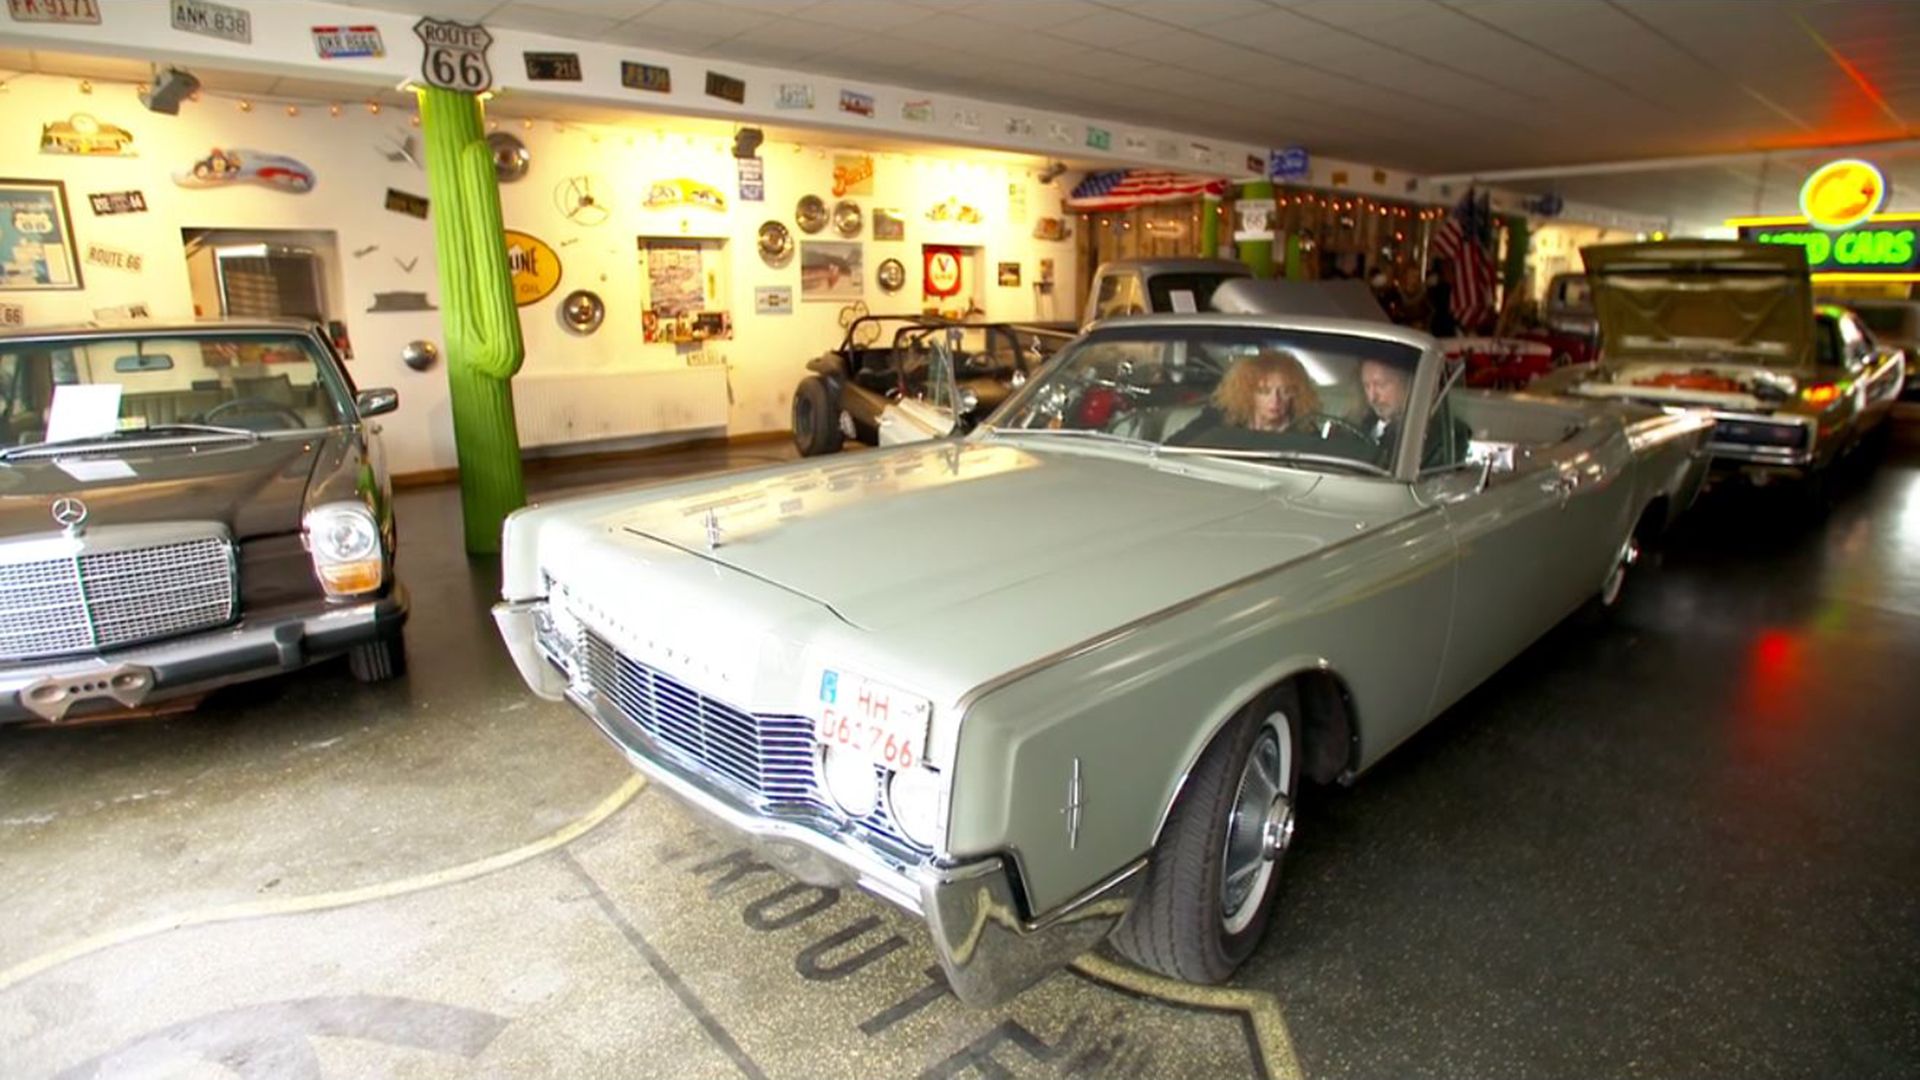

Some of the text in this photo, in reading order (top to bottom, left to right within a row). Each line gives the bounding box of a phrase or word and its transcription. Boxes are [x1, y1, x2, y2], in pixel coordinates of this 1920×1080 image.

[176, 5, 208, 27] ANK
[425, 25, 481, 47] ROUTE
[432, 49, 482, 87] 66
[89, 246, 142, 271] ROUTE 66
[508, 247, 539, 277] LINE
[1834, 230, 1915, 264] CARS
[857, 686, 890, 720] HH
